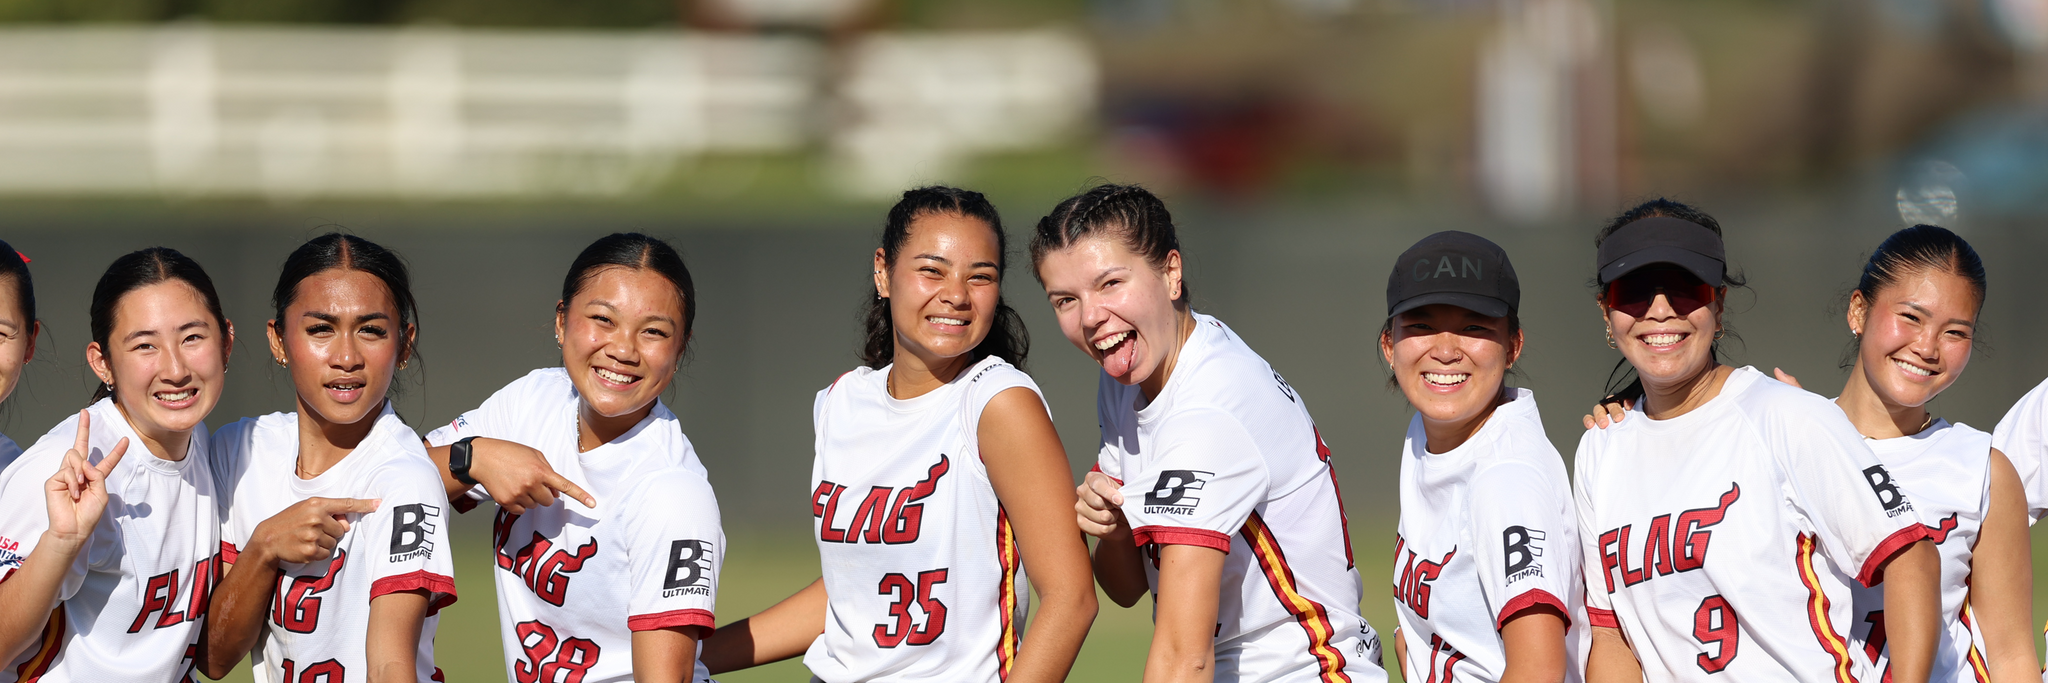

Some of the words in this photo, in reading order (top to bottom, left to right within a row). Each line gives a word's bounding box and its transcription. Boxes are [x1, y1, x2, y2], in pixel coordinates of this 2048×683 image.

[1413, 255, 1483, 283] CAN
[812, 453, 950, 545] FLAG
[1144, 506, 1196, 516] ULTIMATE
[1145, 470, 1215, 507] BE
[390, 503, 440, 555] BE
[1503, 525, 1546, 579] BE
[1598, 481, 1741, 594] FLAG
[389, 549, 432, 563] ULTIMATE
[663, 539, 713, 589] BE
[662, 587, 710, 599] ULTIMATE
[872, 567, 949, 649] 35
[1693, 594, 1740, 675] 9
